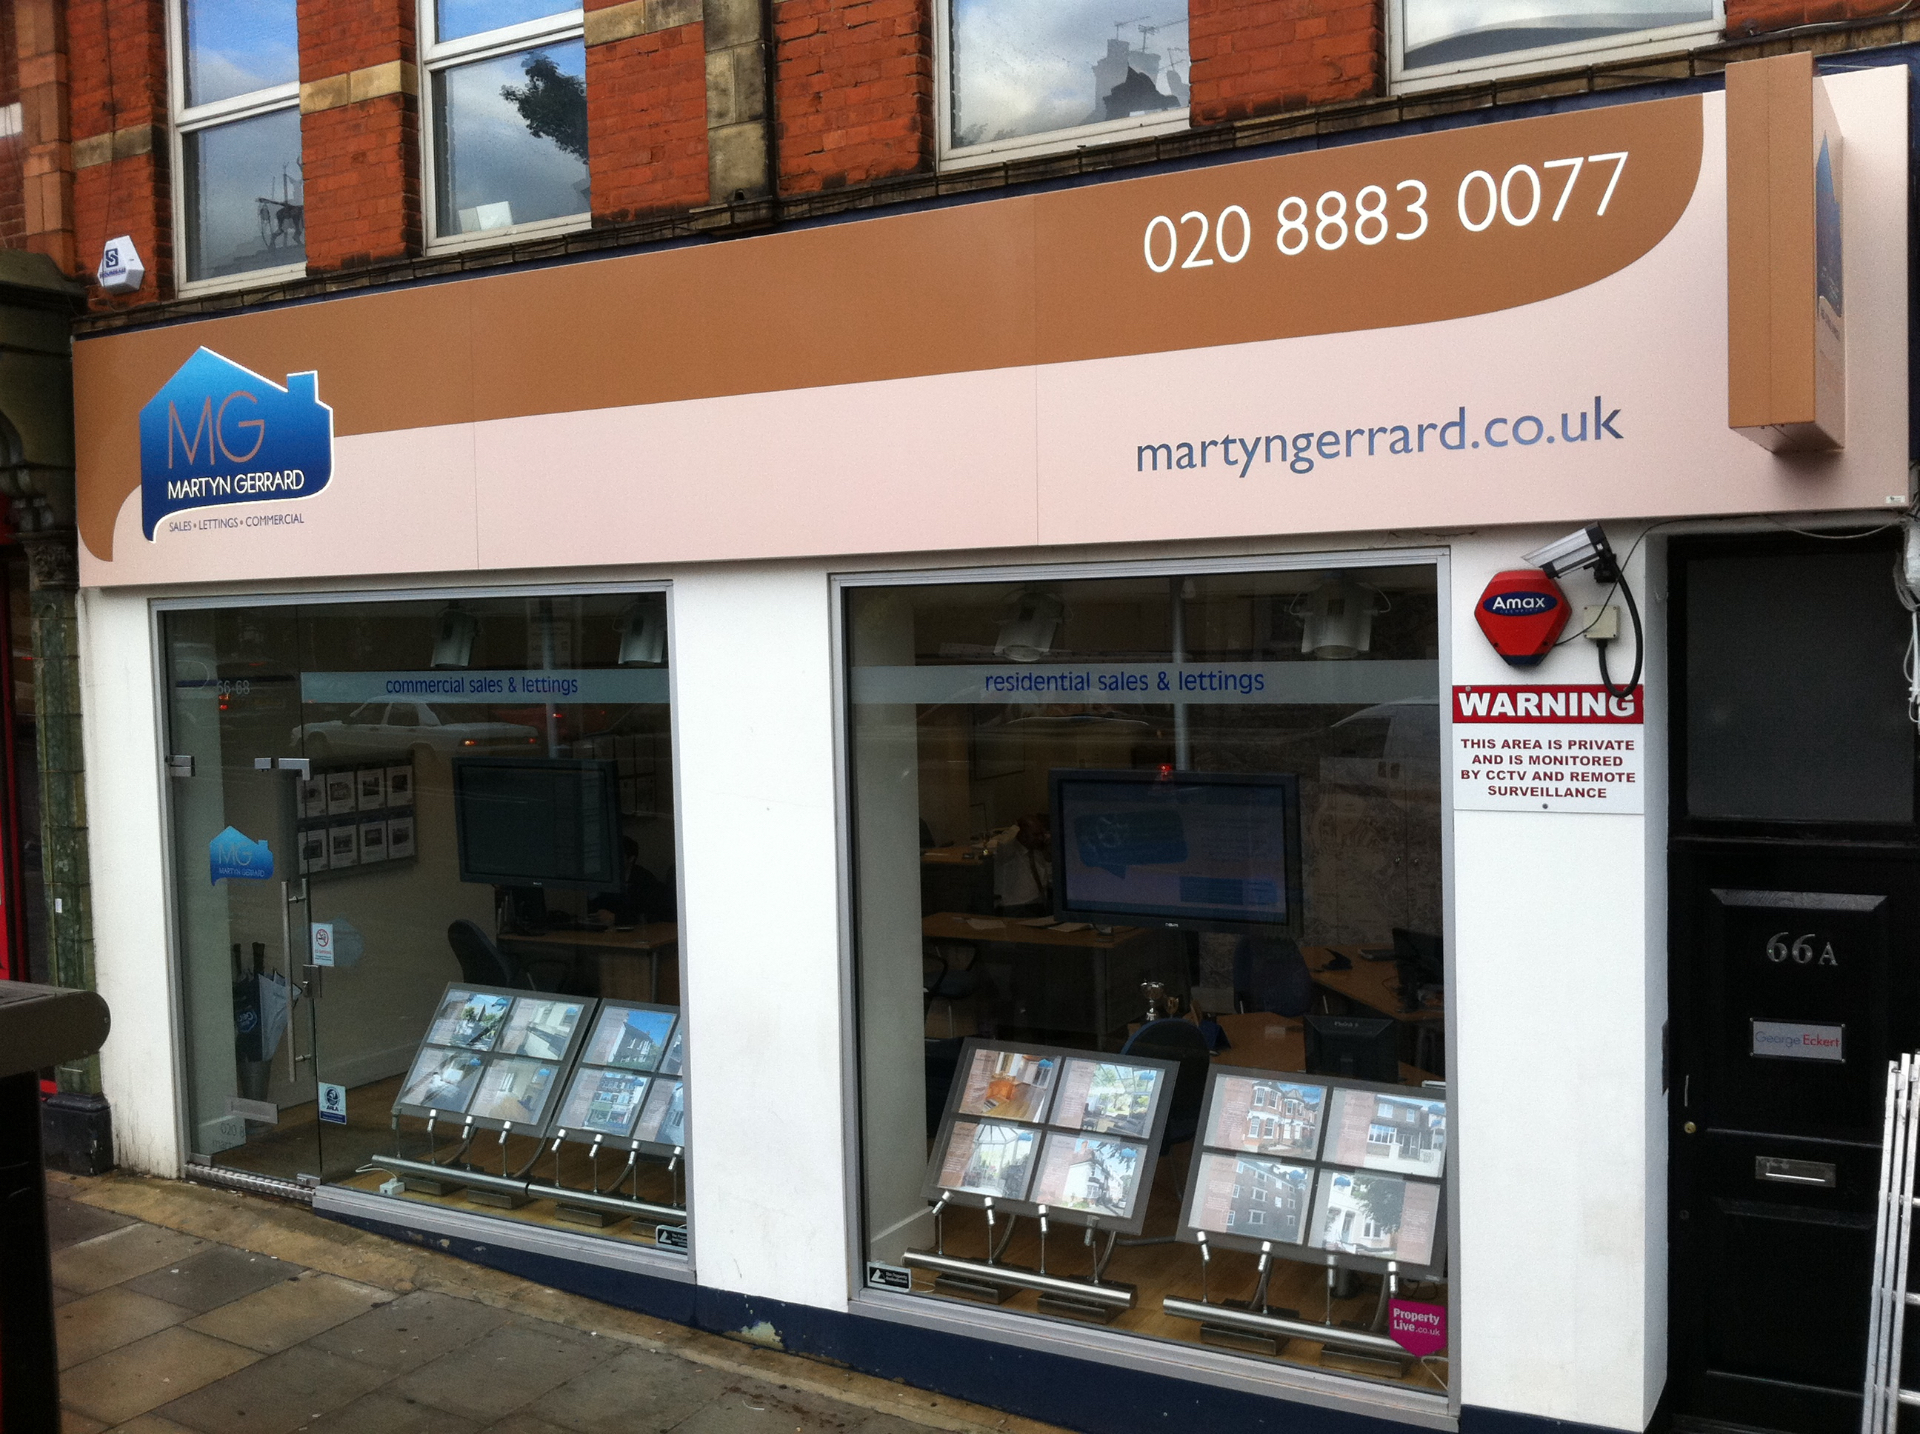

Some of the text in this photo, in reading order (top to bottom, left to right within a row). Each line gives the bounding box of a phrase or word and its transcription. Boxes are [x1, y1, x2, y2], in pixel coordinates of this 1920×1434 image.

[1143, 151, 1629, 273] 020 8883 0077
[168, 390, 265, 469] MG
[1136, 396, 1624, 478] martyngerrard.co.uk
[168, 469, 305, 500] MARTYN GERRARD
[169, 513, 305, 532] SALES LETTINGS COMMERCIAL
[1492, 596, 1545, 610] Amax
[386, 676, 578, 696] commercial sales & lettings
[985, 670, 1265, 694] residential sales & lettings
[1458, 692, 1635, 717] WARNING
[1461, 738, 1635, 751] THIS AREA IS PRIVATE
[1472, 754, 1623, 767] AND IS MONITORED
[1461, 769, 1636, 783] BY CCTV AND REMOTE
[1487, 785, 1607, 799] SURVEILLANCE
[1755, 1030, 1840, 1048] George Eckert
[1393, 1308, 1440, 1326] Property
